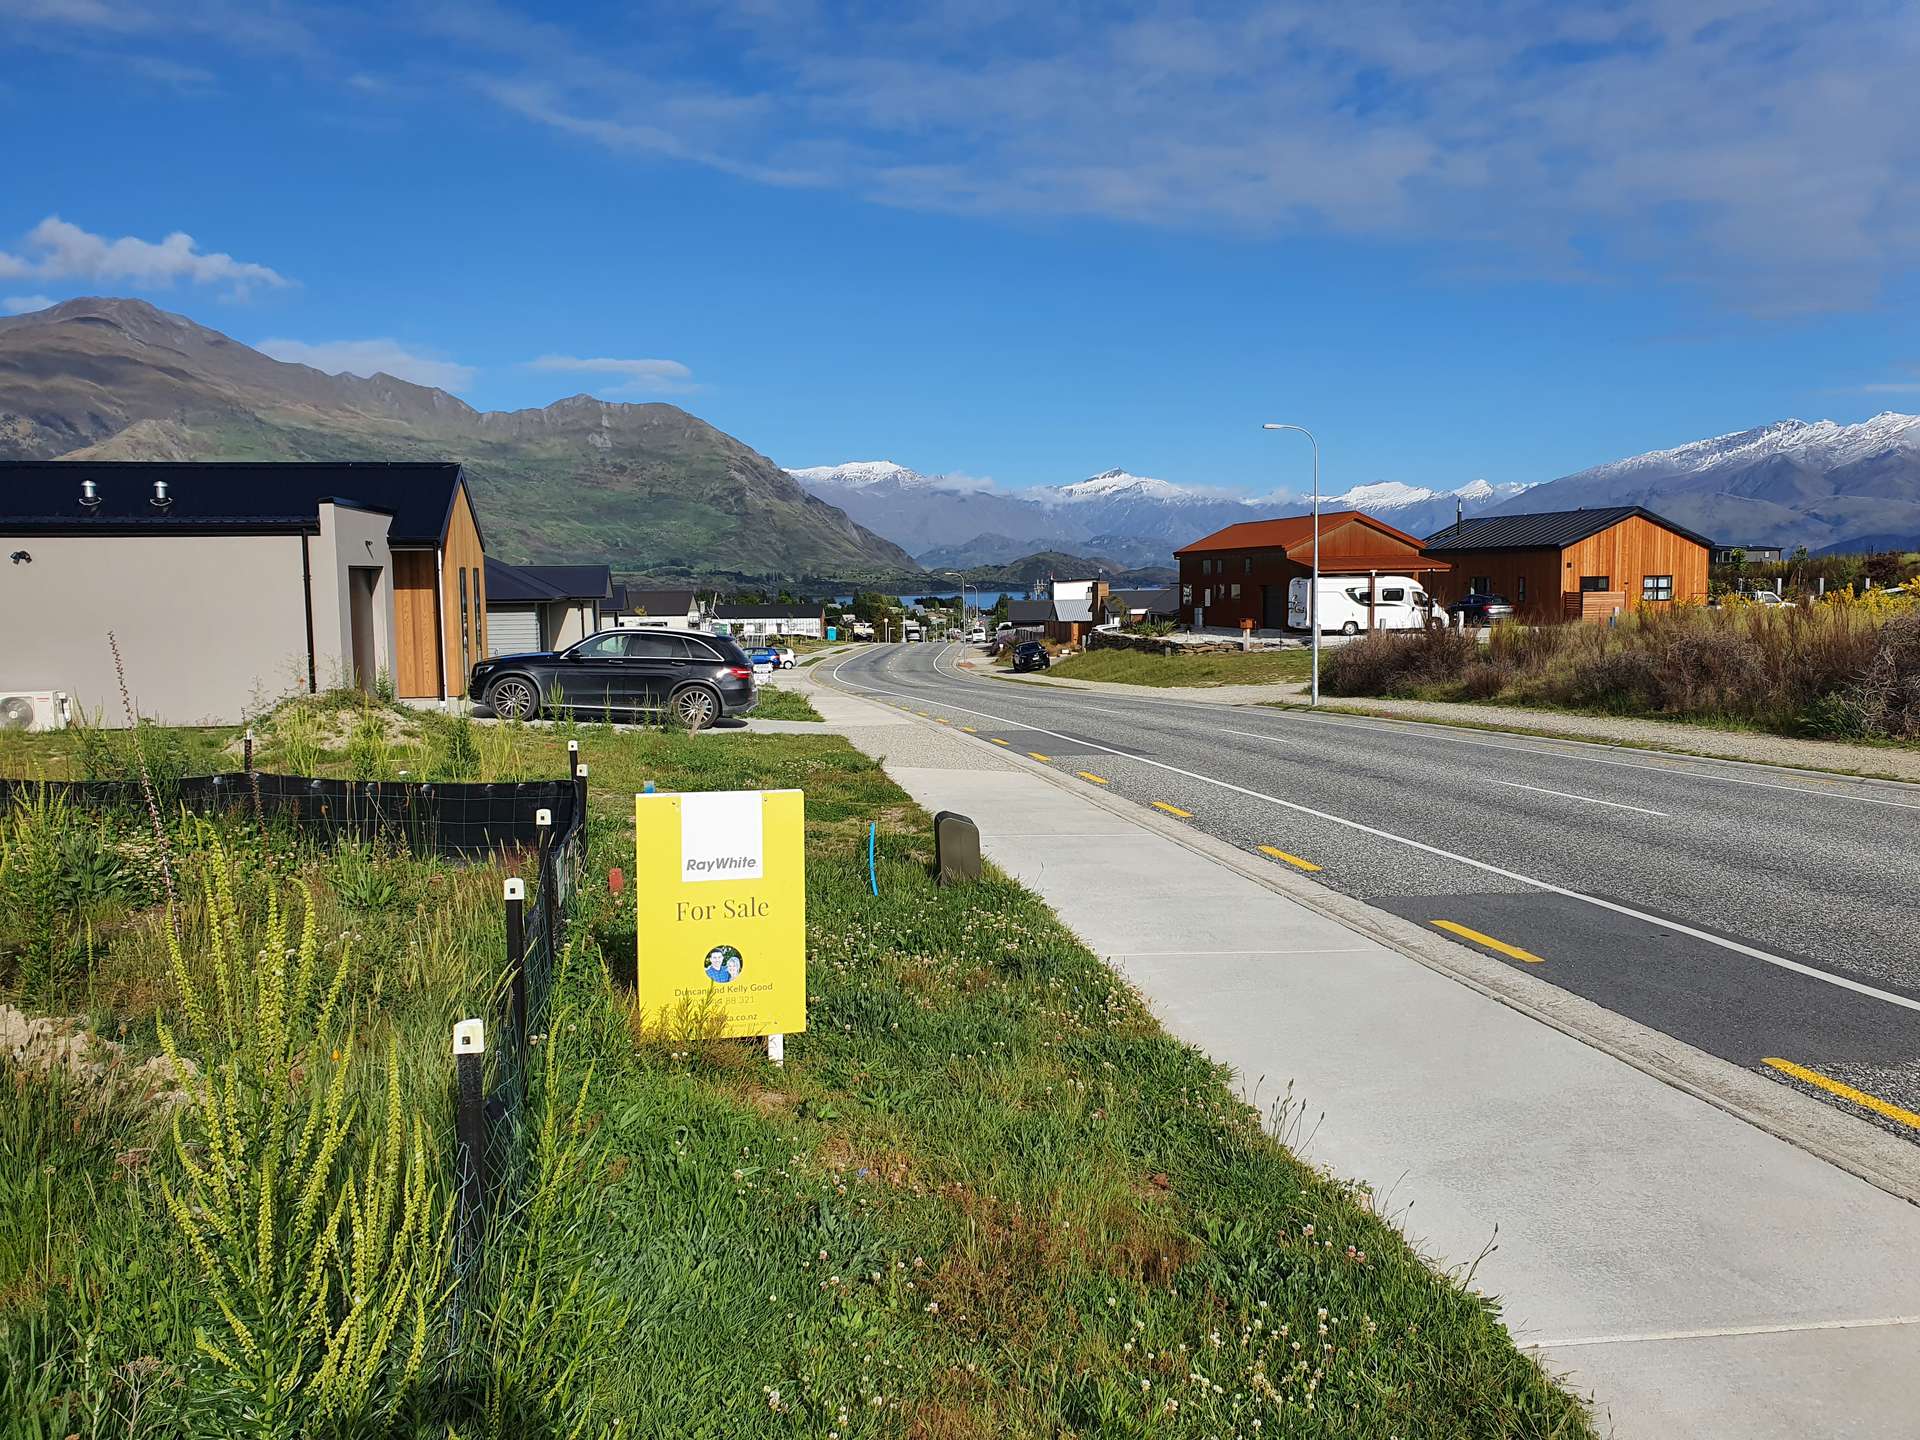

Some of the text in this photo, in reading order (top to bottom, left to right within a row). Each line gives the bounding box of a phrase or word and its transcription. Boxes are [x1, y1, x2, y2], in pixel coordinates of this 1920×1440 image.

[676, 896, 769, 922] For Sale
[708, 986, 725, 995] nd
[727, 984, 748, 993] Kelly
[750, 983, 773, 992] Good
